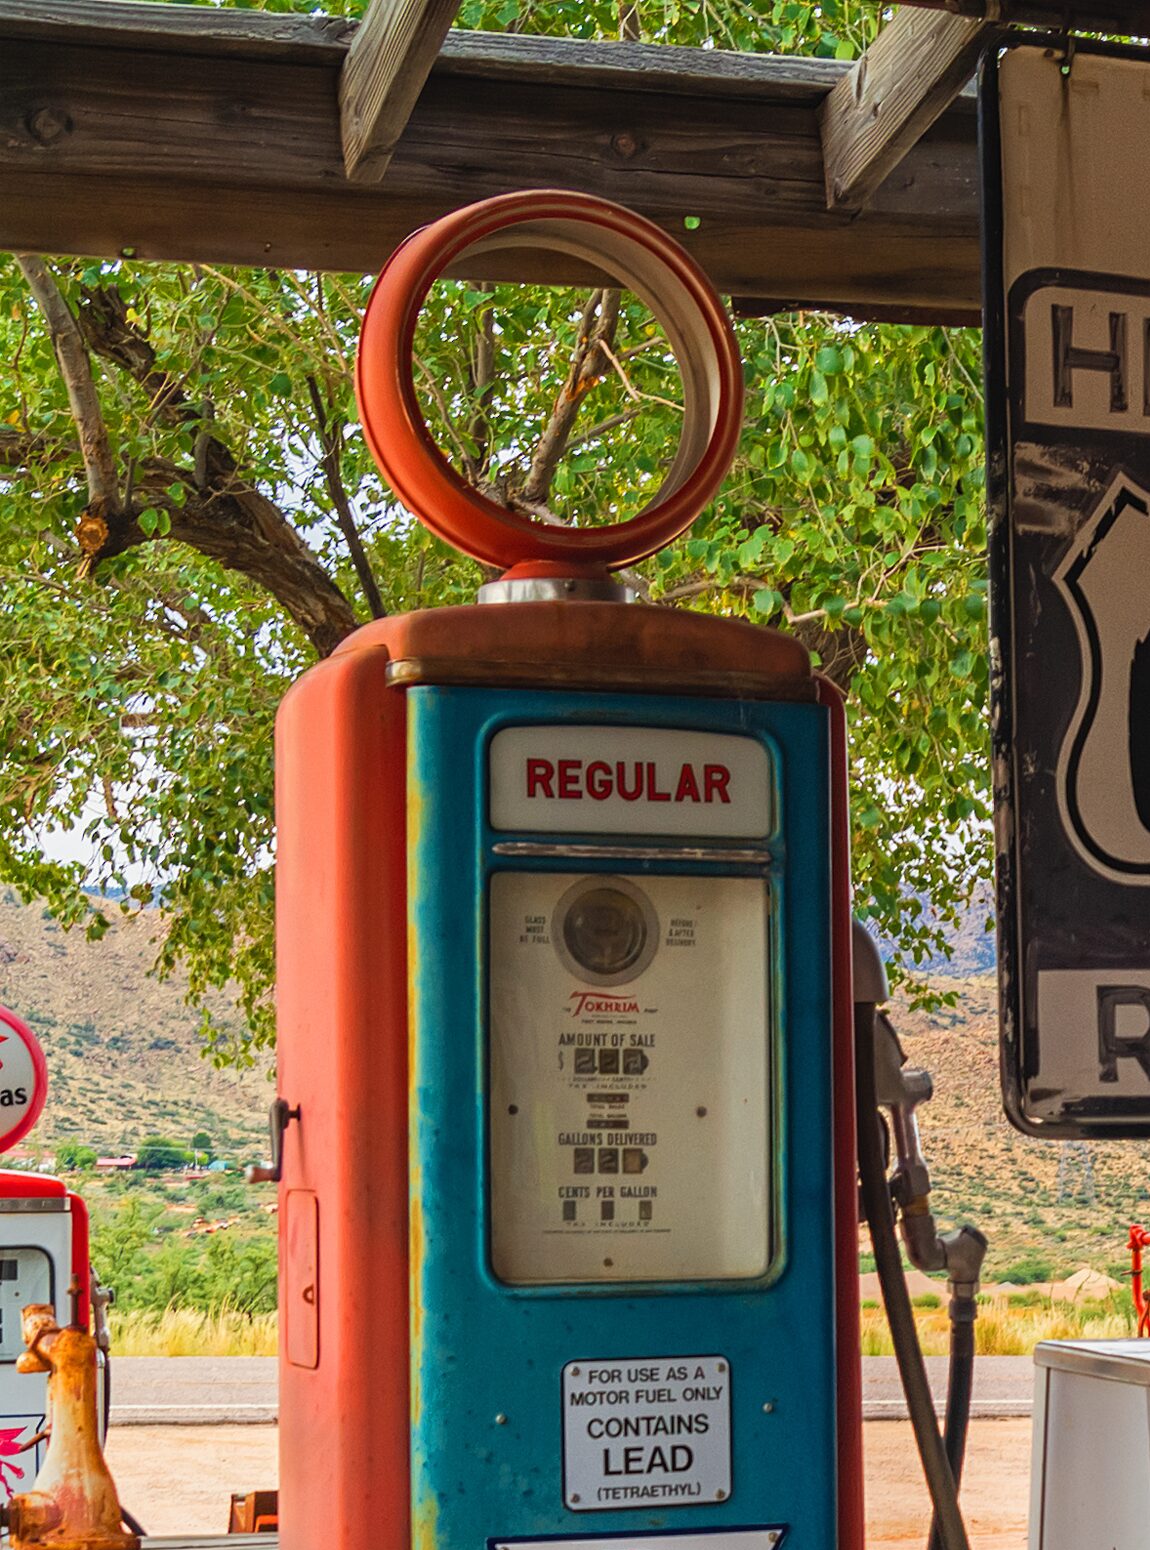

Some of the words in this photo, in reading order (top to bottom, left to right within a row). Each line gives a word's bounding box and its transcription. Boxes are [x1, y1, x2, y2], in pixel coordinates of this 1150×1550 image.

[526, 757, 732, 804] REGULAR
[558, 1032, 608, 1047] AMOUNT
[611, 1033, 626, 1048] OF
[630, 1034, 656, 1048] SALE
[558, 1132, 603, 1146] GALLONS
[607, 1132, 658, 1146] DELIVERED
[558, 1186, 590, 1198] CENTS
[596, 1186, 615, 1198] PER
[620, 1186, 658, 1198] GALLON
[588, 1369, 622, 1384] FOR
[627, 1367, 660, 1383] USE
[666, 1366, 688, 1381] AS
[693, 1366, 706, 1380] A
[569, 1390, 630, 1406] MOTOR
[634, 1388, 677, 1404] FUEL
[682, 1386, 723, 1402] ONLY
[586, 1413, 710, 1440] CONTAINS
[602, 1444, 695, 1477] LEAD
[596, 1480, 703, 1502] (TETRAETHYL)
